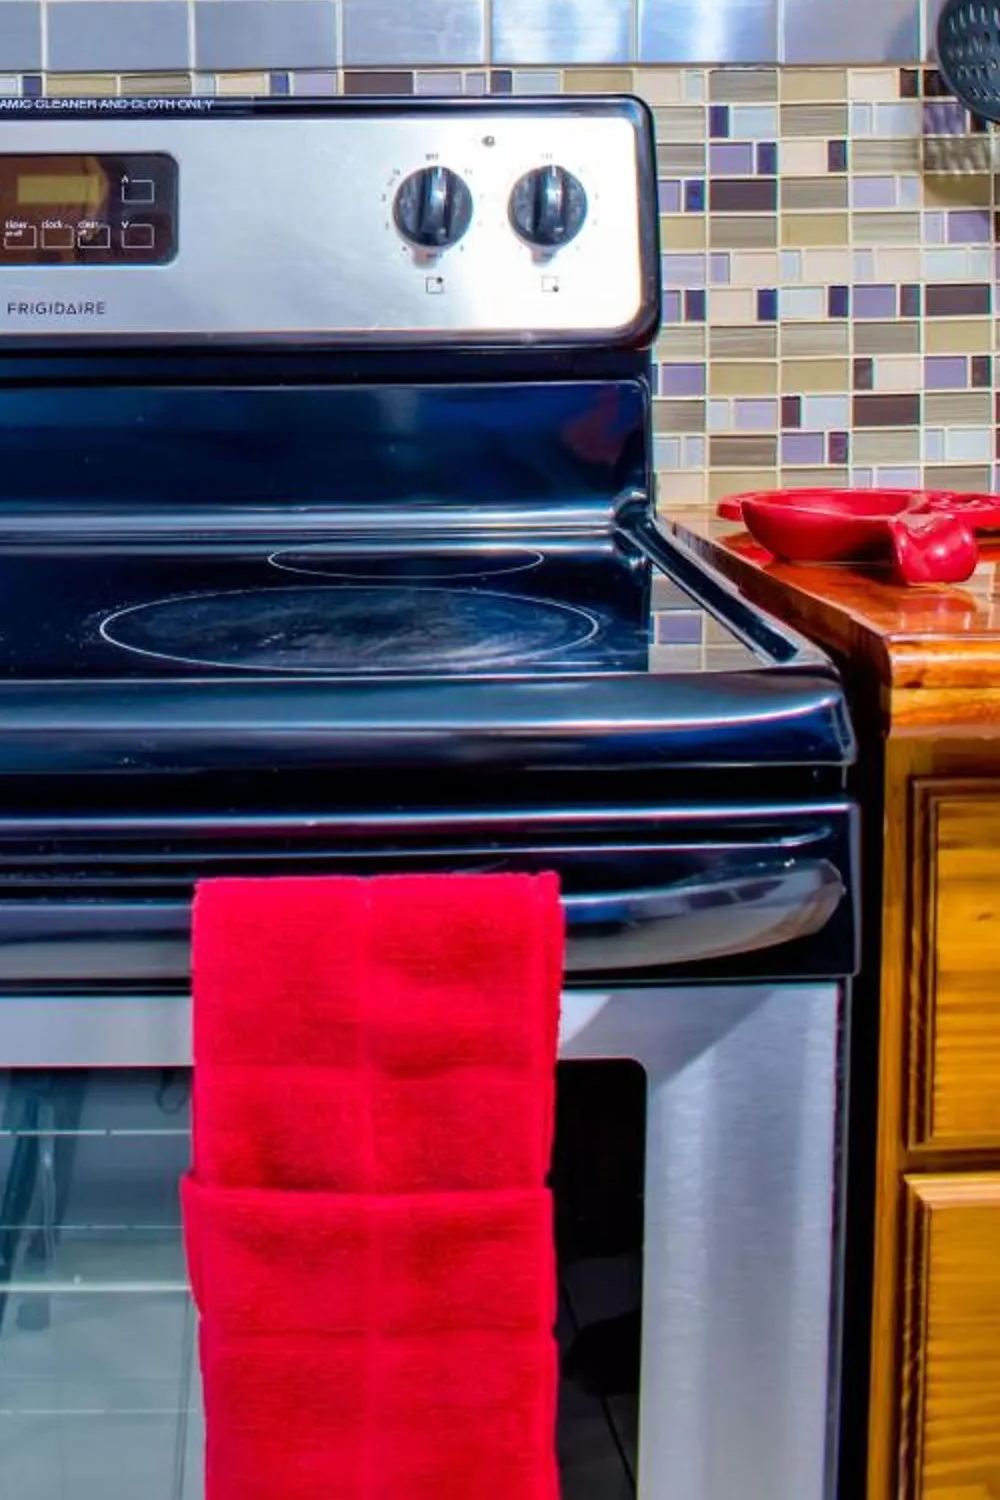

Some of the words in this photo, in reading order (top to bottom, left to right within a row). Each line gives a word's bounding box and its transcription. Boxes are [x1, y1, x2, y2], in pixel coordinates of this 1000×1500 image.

[35, 99, 97, 110] CLEANER
[101, 99, 127, 110] AND
[131, 99, 175, 110] CLOTH
[177, 99, 214, 110] ONLY
[7, 302, 107, 316] FRIGIDAIRE
